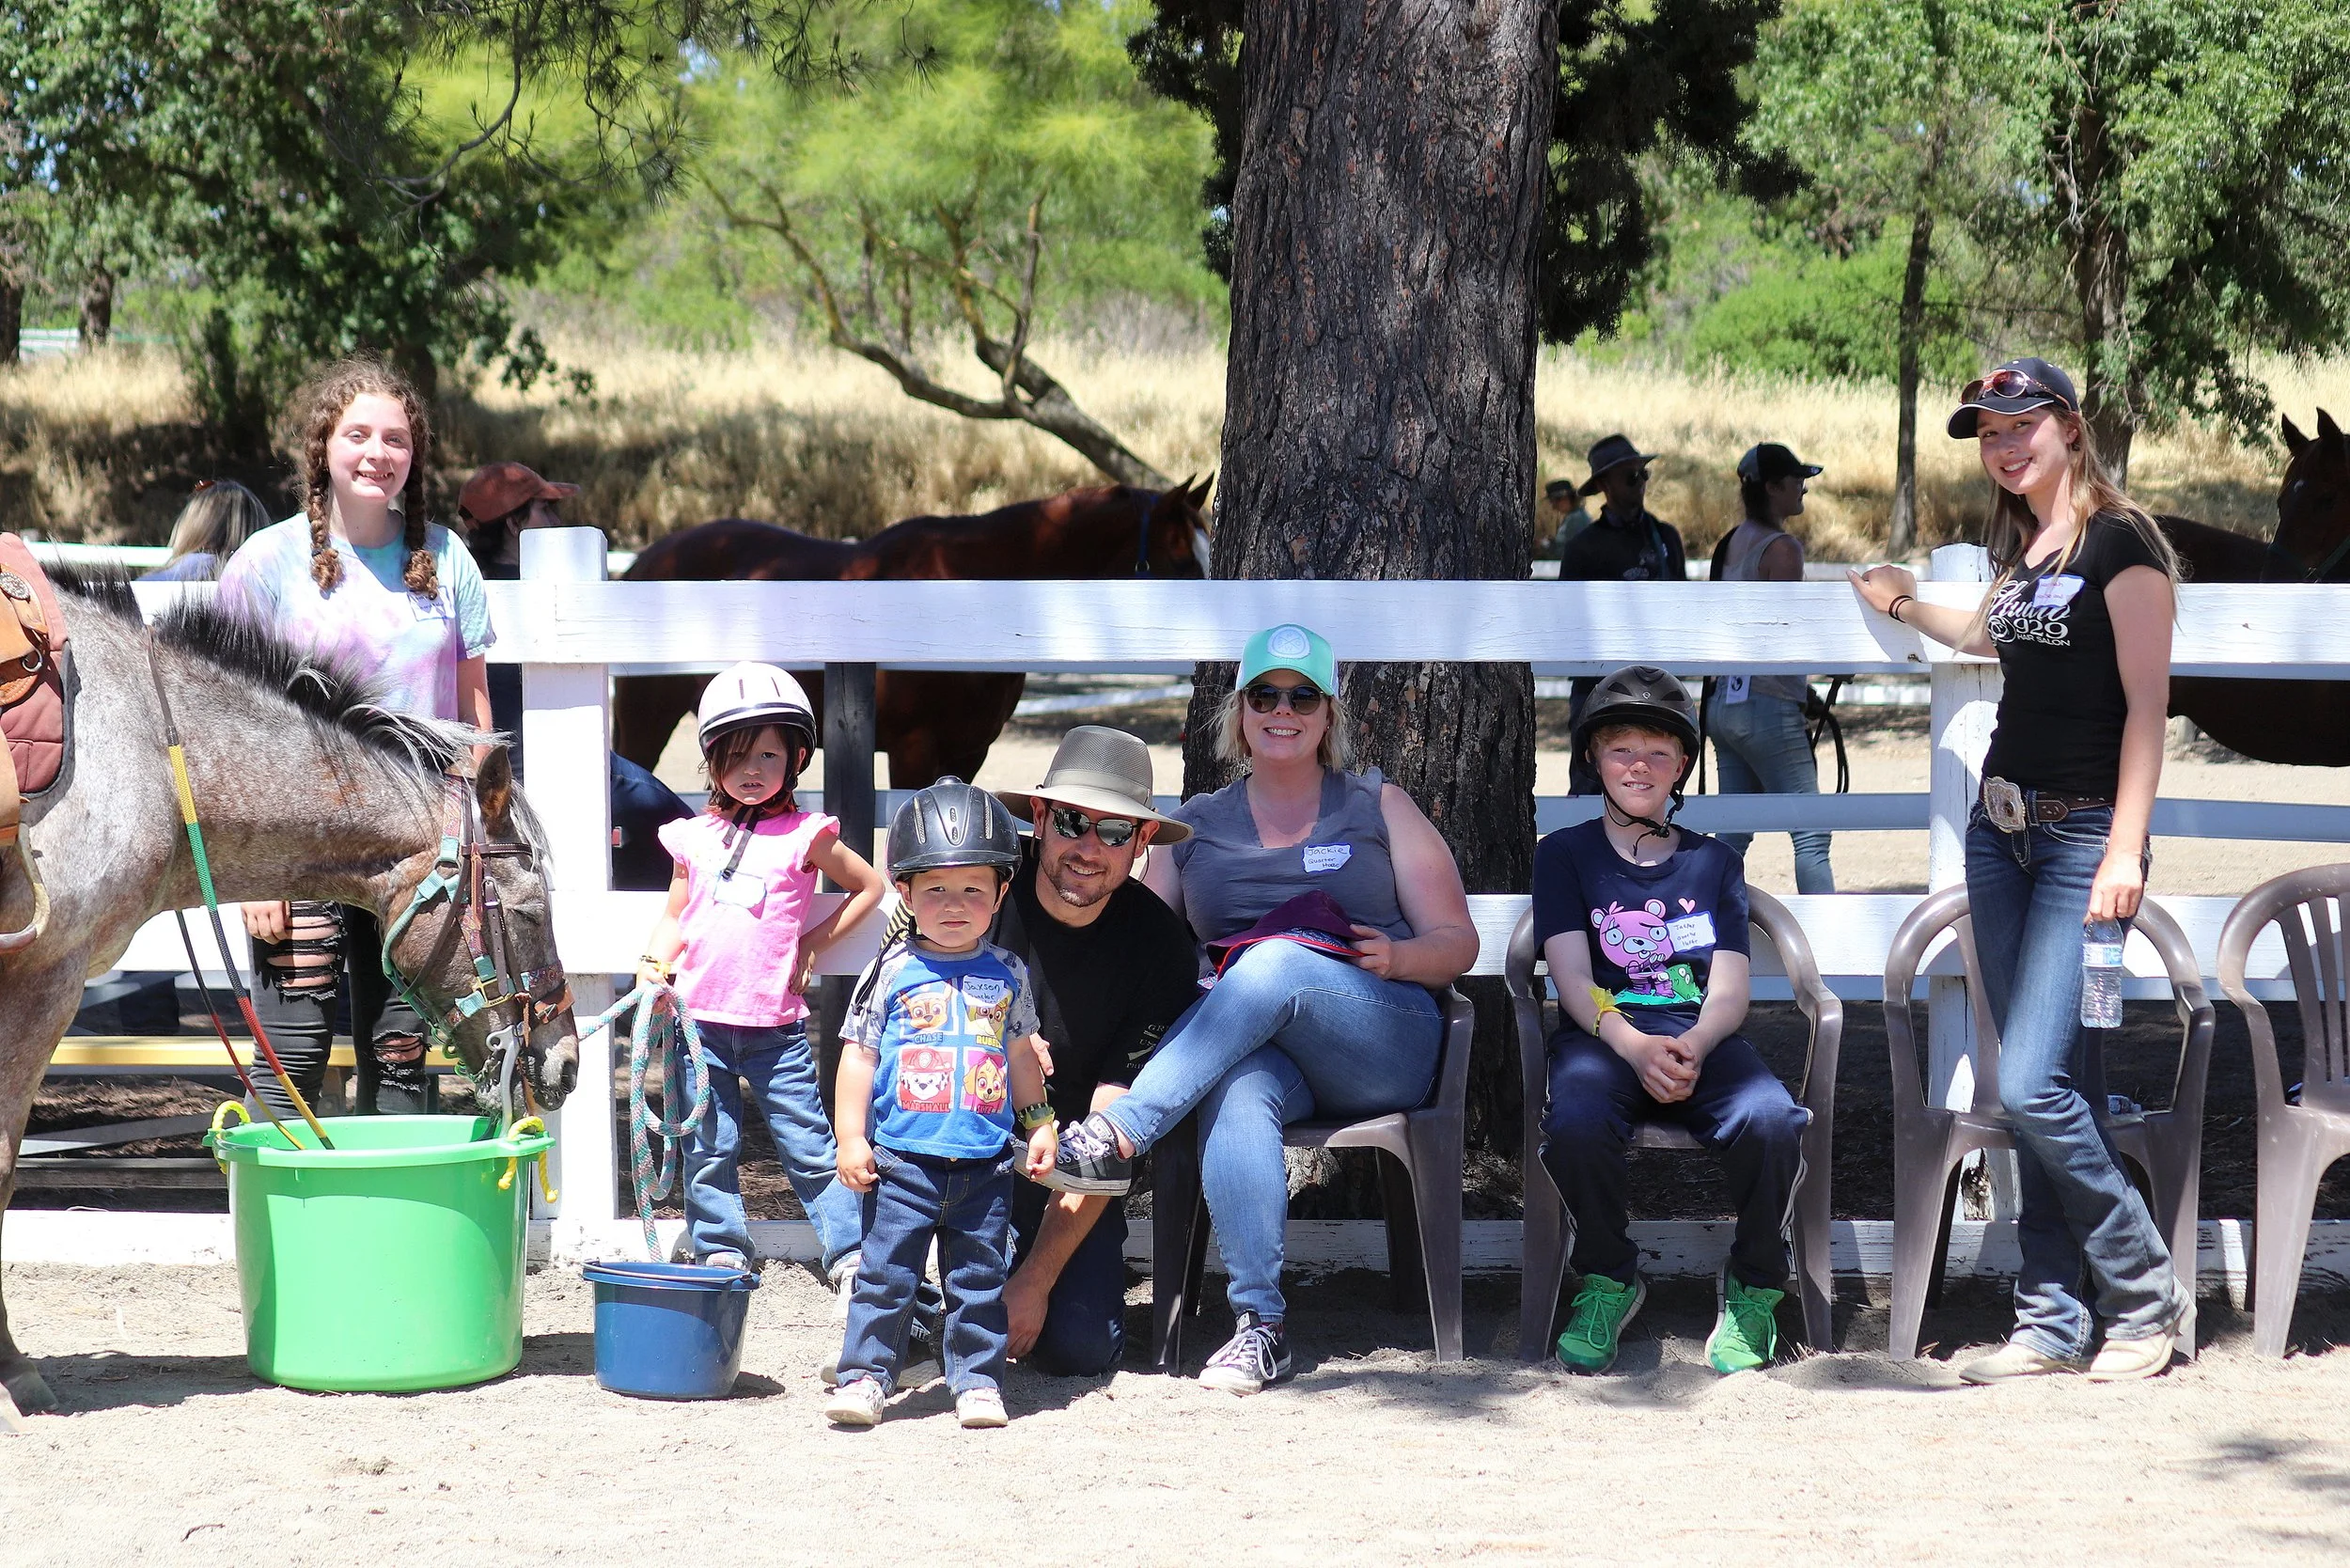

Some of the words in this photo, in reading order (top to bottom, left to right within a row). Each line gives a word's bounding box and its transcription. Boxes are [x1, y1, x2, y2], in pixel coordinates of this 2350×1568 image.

[2013, 618, 2068, 639] 929
[2016, 633, 2035, 642] HAIR
[2036, 636, 2071, 647] SALON
[964, 980, 1001, 993] Jaxson
[914, 1032, 944, 1044] CHASE
[901, 1101, 950, 1113] MARSHALL
